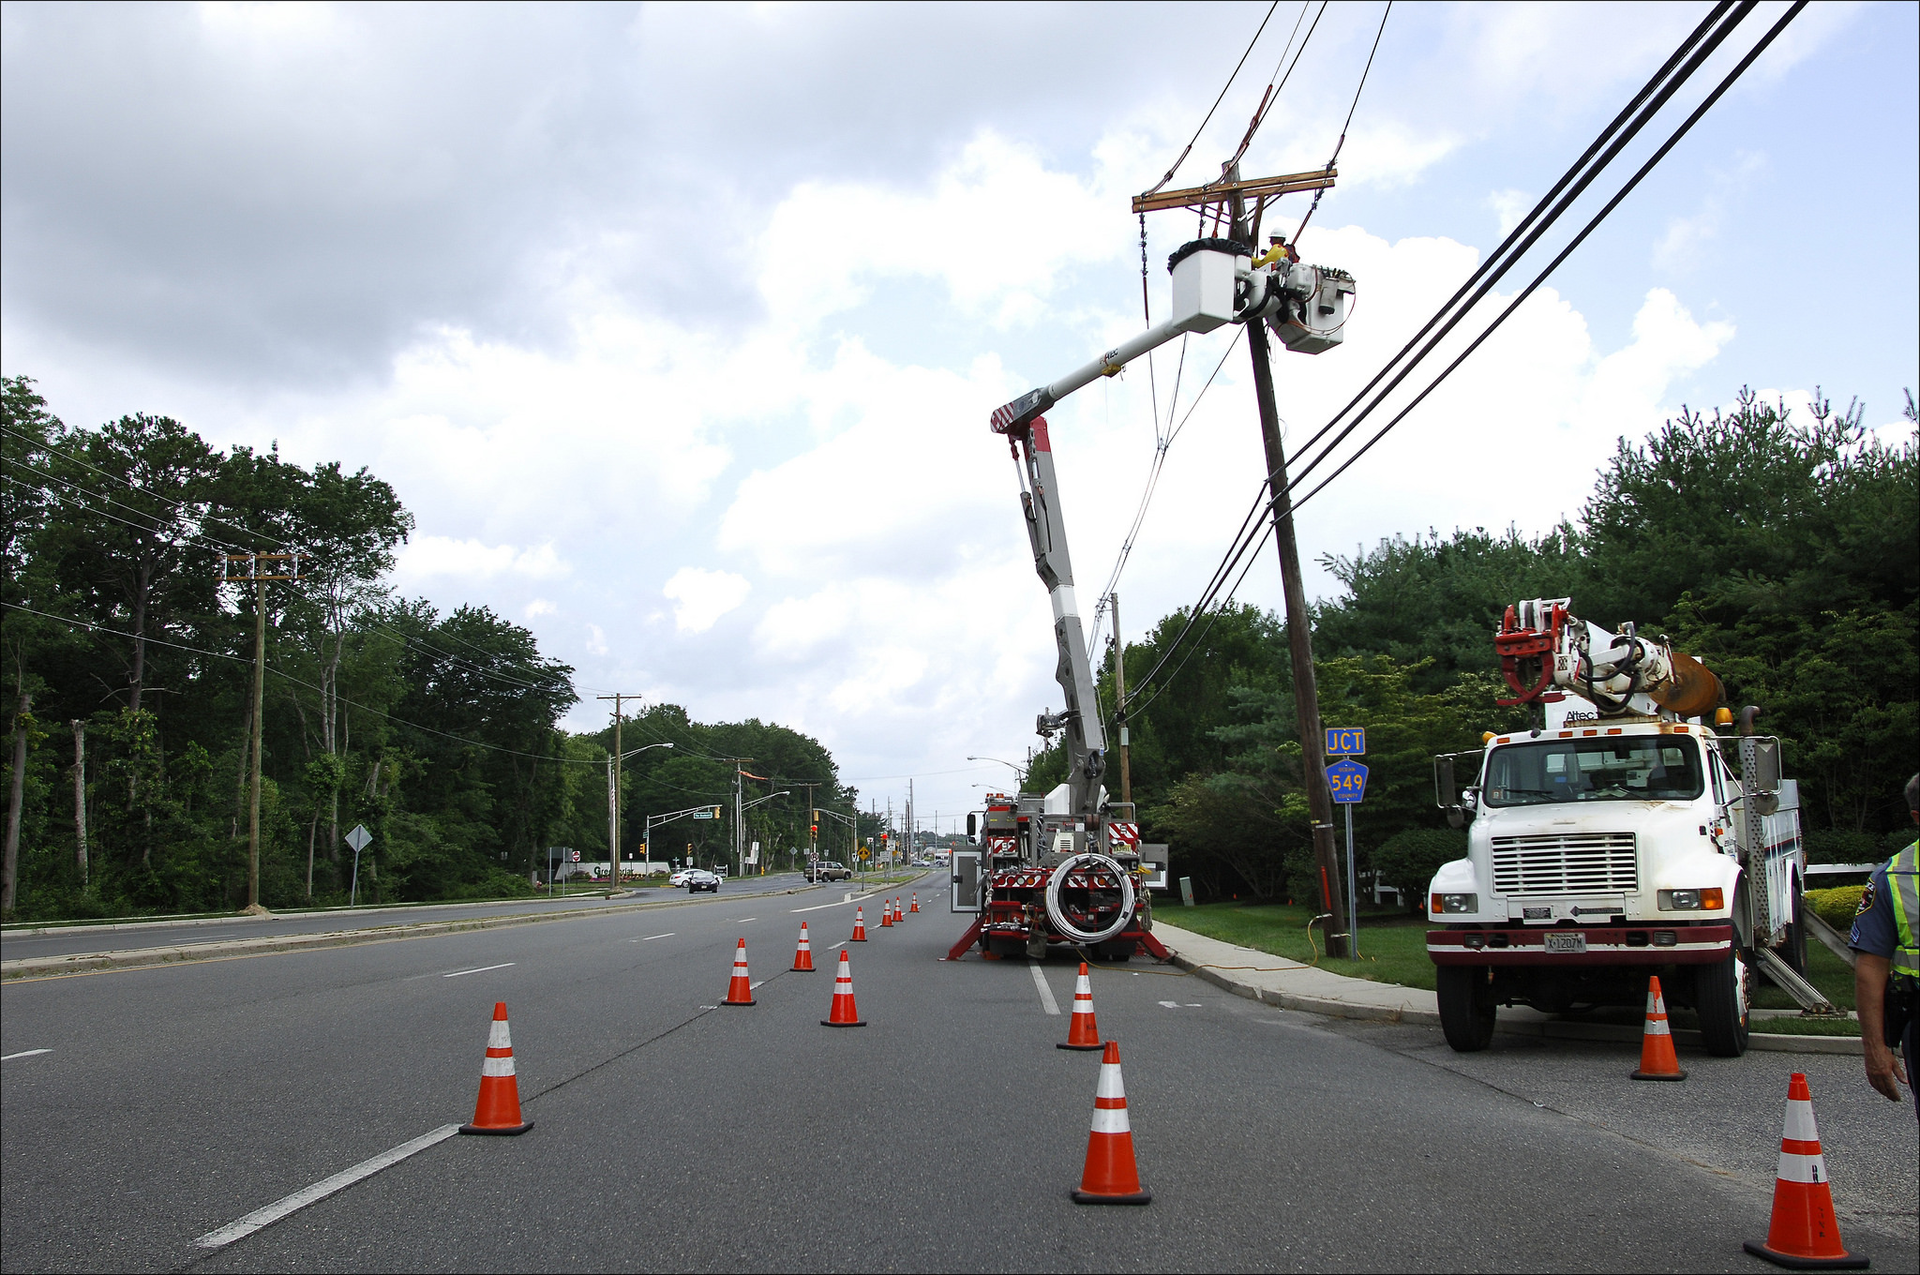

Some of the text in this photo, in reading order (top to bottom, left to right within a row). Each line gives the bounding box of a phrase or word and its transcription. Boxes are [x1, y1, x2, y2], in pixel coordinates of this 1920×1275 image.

[1566, 711, 1594, 721] Altec
[1328, 732, 1362, 751] JCT
[1332, 774, 1363, 791] 549
